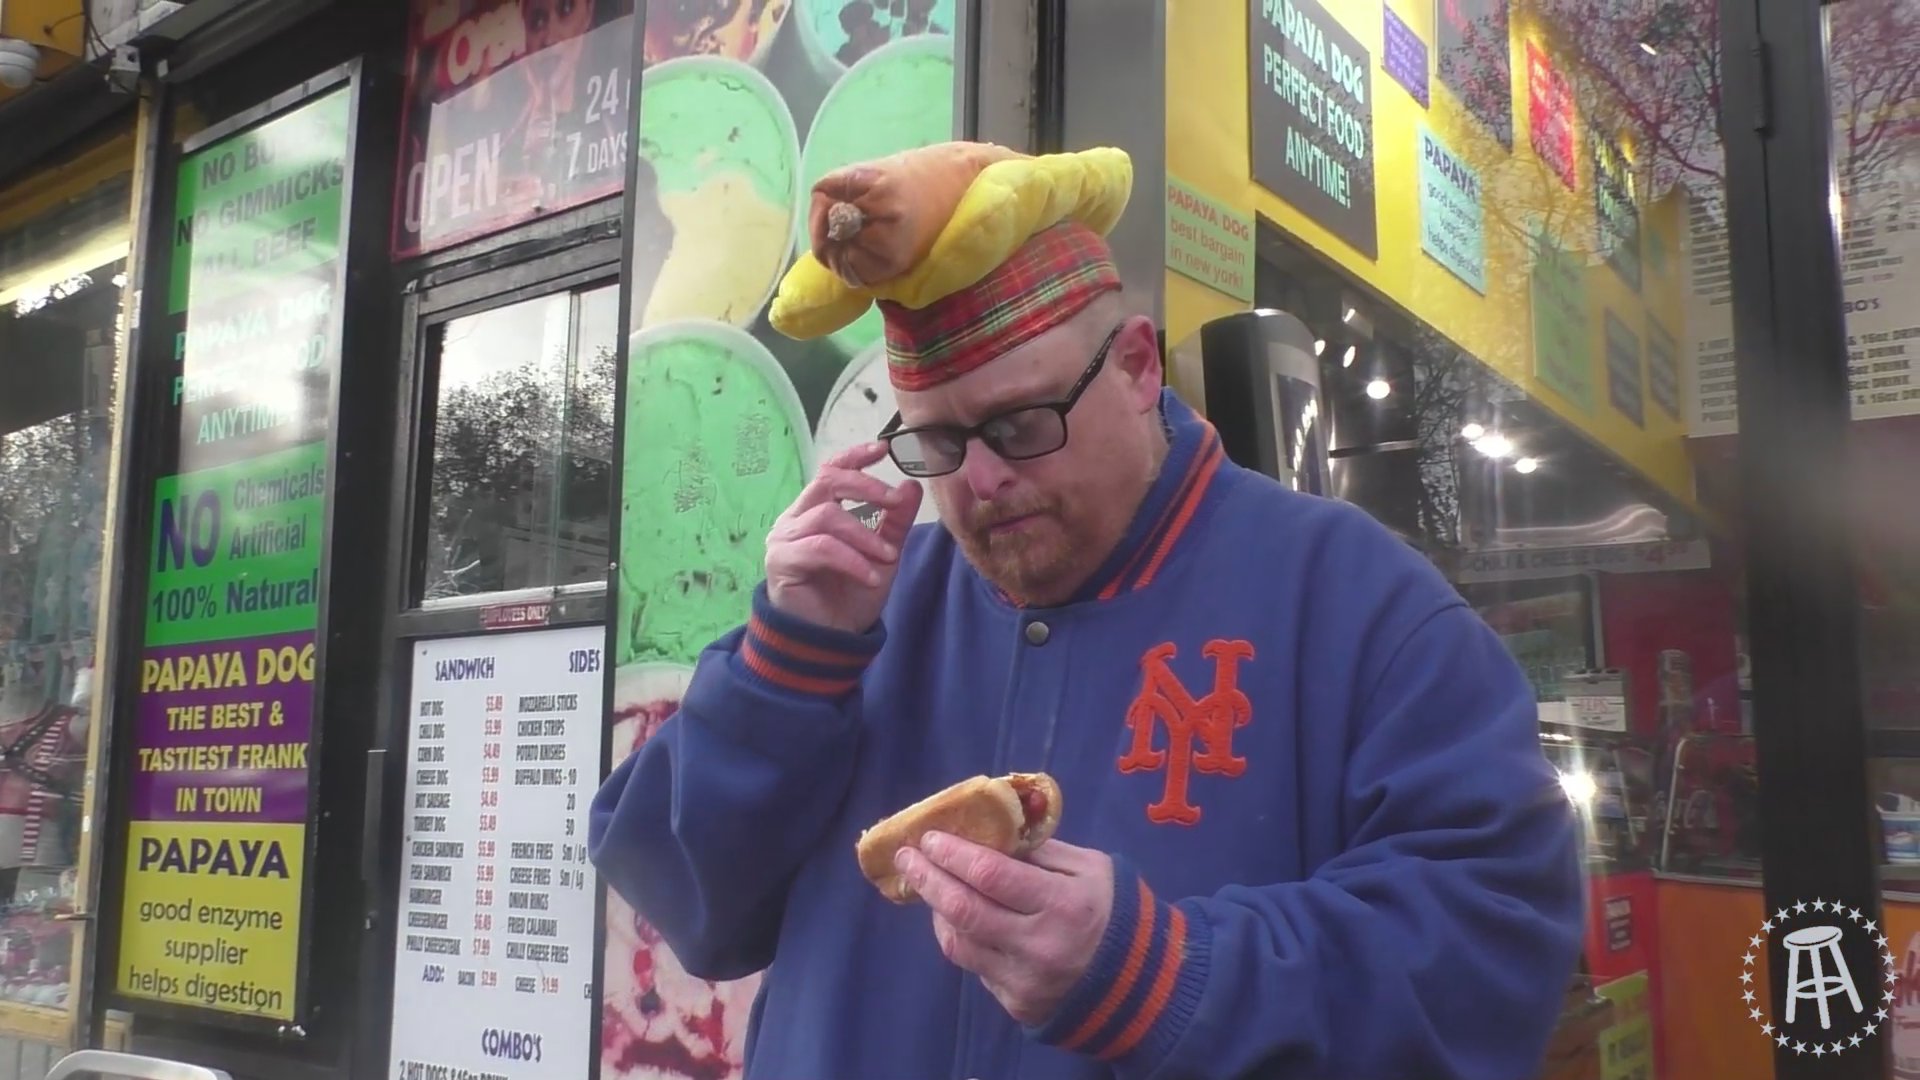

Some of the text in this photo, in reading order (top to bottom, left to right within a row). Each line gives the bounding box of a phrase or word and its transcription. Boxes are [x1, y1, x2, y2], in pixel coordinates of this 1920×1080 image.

[1263, 0, 1328, 72] PAPAYA
[1331, 42, 1364, 104] DOG
[585, 68, 619, 124] 24
[1264, 43, 1324, 128] PERFECT
[1327, 96, 1364, 160] FOOD
[202, 151, 236, 189] NO
[566, 131, 628, 181] 7 DAYS
[1285, 126, 1351, 210] ANYTIME!
[1424, 136, 1478, 204] PAPAYA
[405, 132, 501, 233] OPEN
[176, 157, 344, 247] NO GIMMICKS
[1168, 185, 1249, 241] PAPAYA DOG
[252, 217, 317, 268] BEEF
[1171, 216, 1245, 266] best bargain
[1171, 245, 1183, 261] in
[1186, 253, 1211, 274] new
[233, 462, 325, 511] Chemicals
[157, 489, 308, 573] NO Artificial
[152, 569, 319, 622] 100% Natural
[142, 643, 315, 693] PAPAYA DOG
[435, 650, 600, 682] SANDWICH SIDES
[167, 701, 283, 731] THE BEST &
[432, 701, 444, 716] DOG
[519, 694, 578, 713] MOZZARELLA STICKS
[433, 724, 445, 739] DOG
[518, 719, 565, 737] CHICKEN STRIPS
[139, 742, 308, 772] TASTIEST FRANK
[433, 746, 445, 762] DOG
[437, 770, 448, 785] DOG
[176, 787, 262, 813] IN TOWN
[434, 816, 446, 832] DOG
[139, 837, 290, 879] PAPAYA
[536, 843, 553, 860] FRIES
[533, 868, 551, 885] FRIES
[140, 898, 282, 931] good enzyme
[164, 936, 248, 965] supplier
[129, 965, 282, 1010] helps digestion
[422, 964, 445, 983] ADD:
[481, 1028, 542, 1063] COMBO'S
